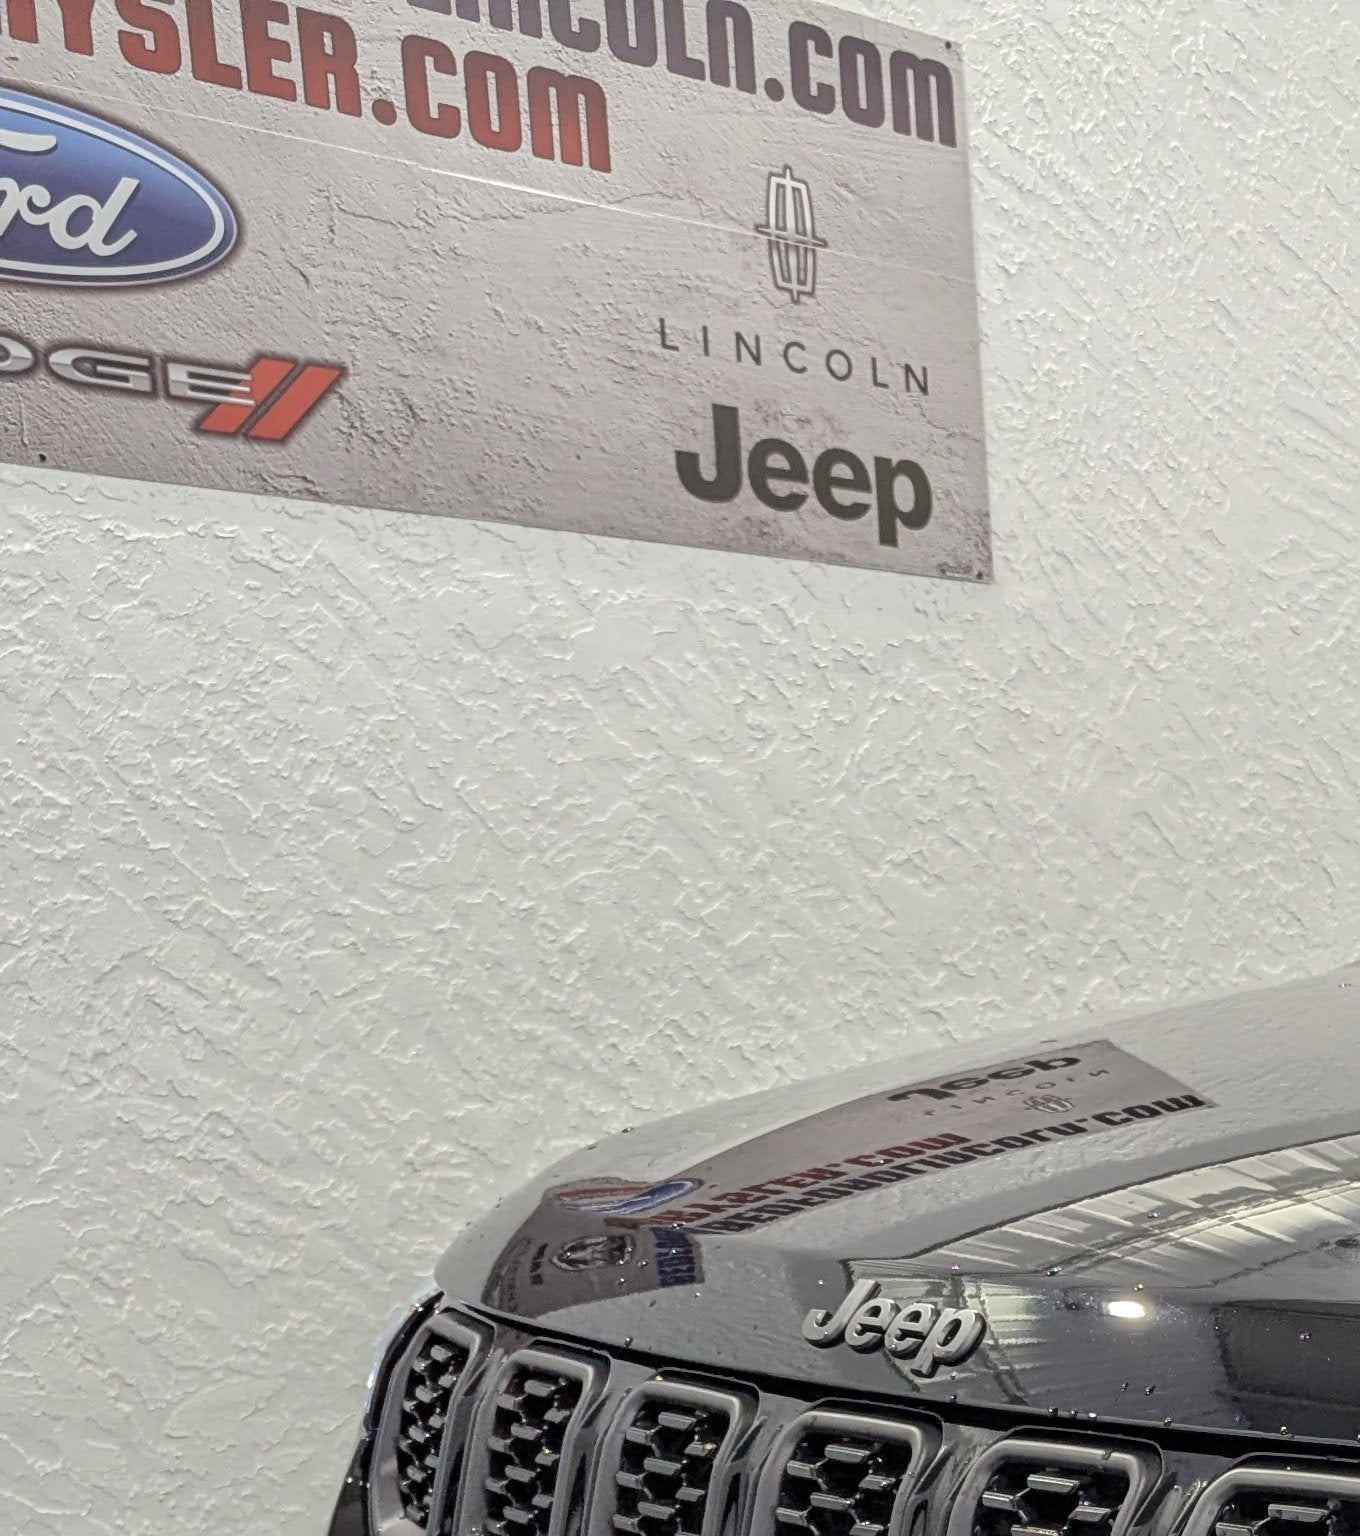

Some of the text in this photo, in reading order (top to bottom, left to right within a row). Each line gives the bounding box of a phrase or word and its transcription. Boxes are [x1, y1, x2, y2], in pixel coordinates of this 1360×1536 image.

[659, 317, 929, 396] LINCOLN
[674, 403, 933, 548] Jeep
[802, 1279, 987, 1378] Jeep
